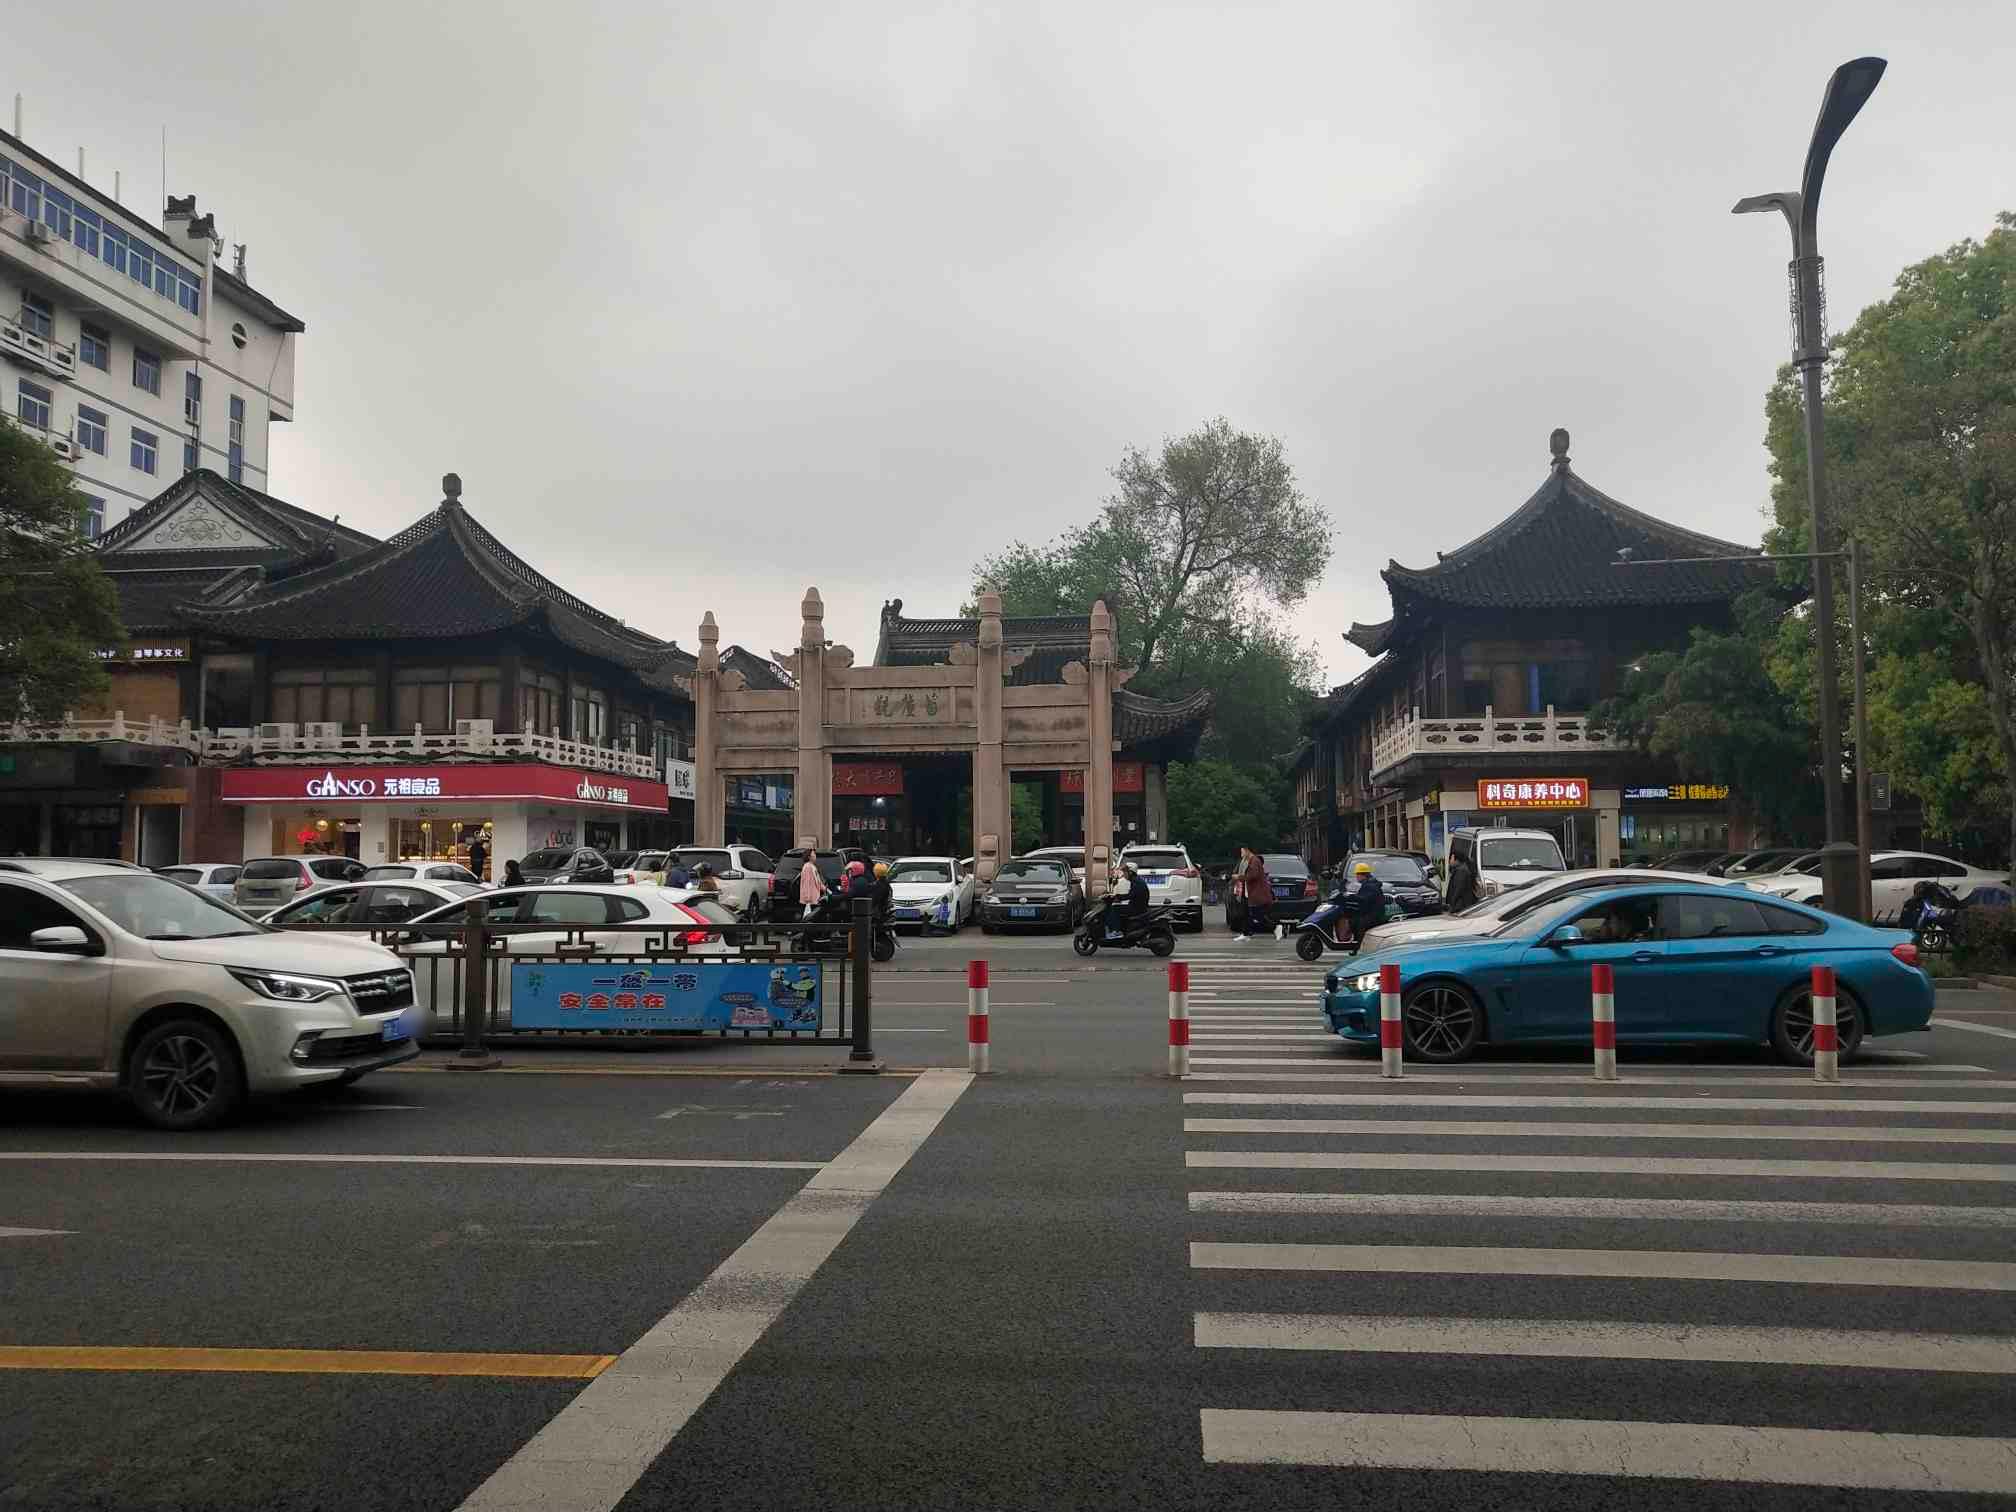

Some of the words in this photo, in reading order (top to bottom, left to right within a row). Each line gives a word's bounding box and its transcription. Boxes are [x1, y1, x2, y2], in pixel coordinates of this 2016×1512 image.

[306, 771, 376, 796] GANSO
[1486, 783, 1582, 800] 科奇康养中心
[559, 991, 666, 1010] 安全常在
